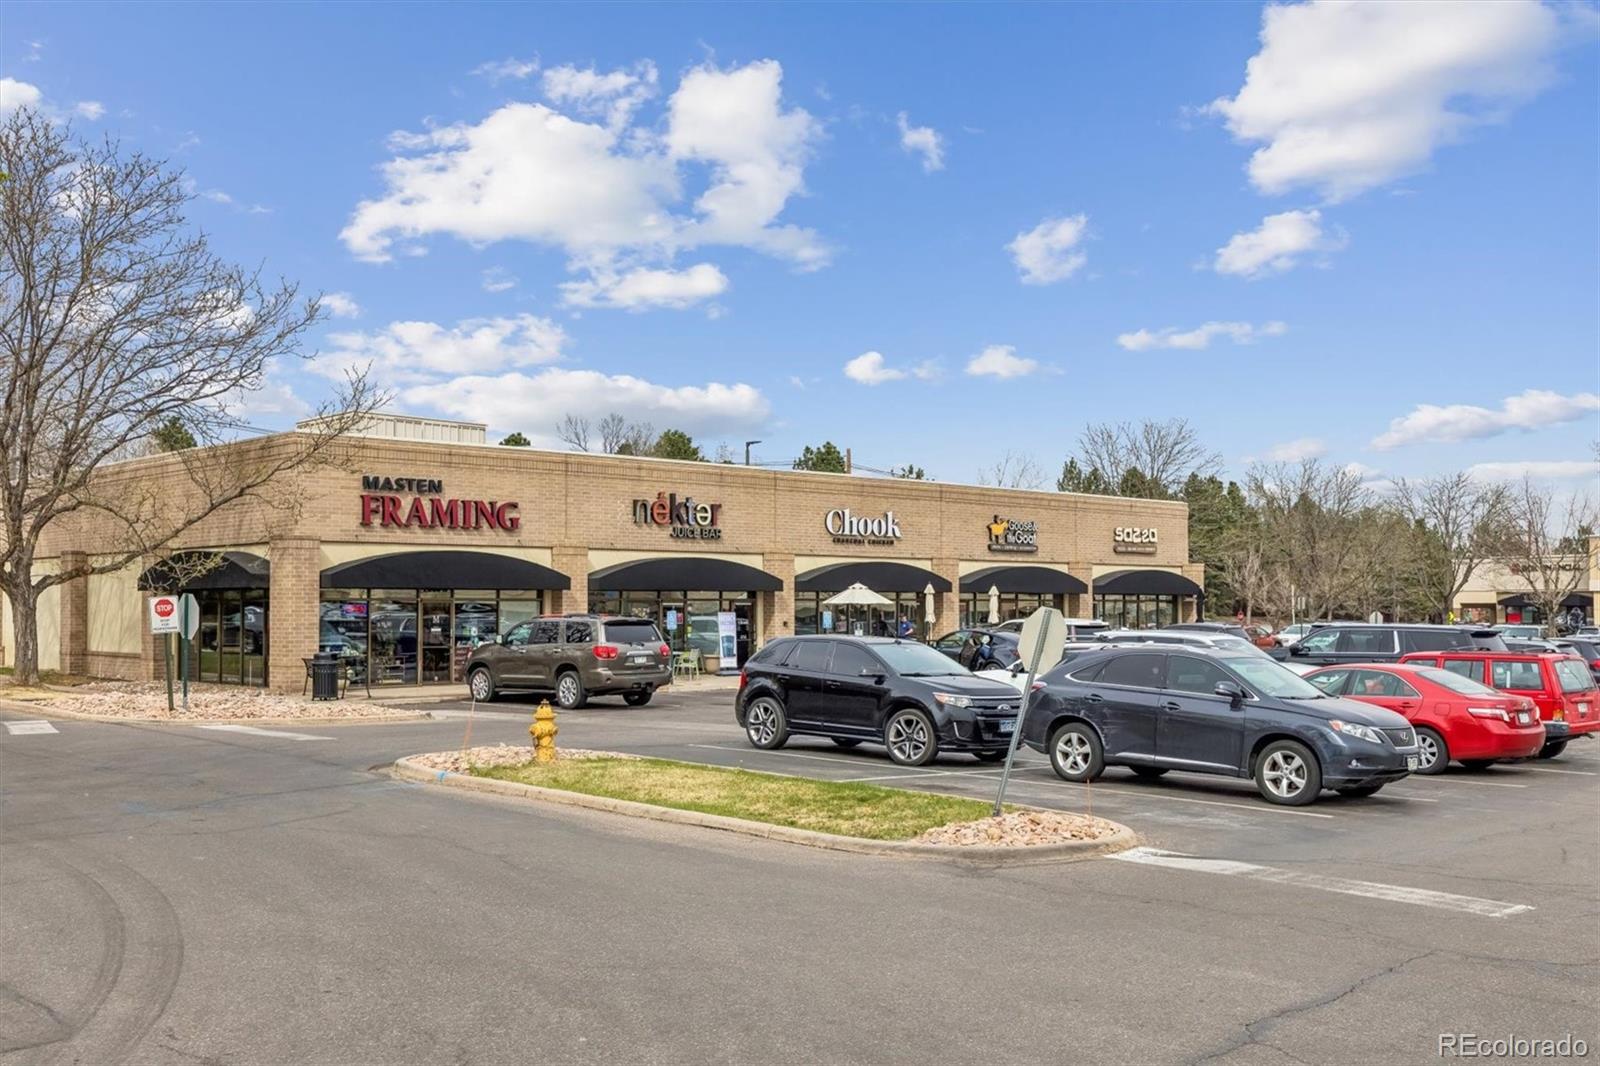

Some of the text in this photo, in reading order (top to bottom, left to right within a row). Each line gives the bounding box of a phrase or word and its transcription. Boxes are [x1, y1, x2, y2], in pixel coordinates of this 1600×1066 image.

[362, 475, 443, 493] MASTEN
[360, 494, 520, 531] FRAMING
[825, 508, 903, 538] Chook
[1008, 519, 1034, 531] Goose
[670, 526, 721, 539] JUICE BAR
[1015, 530, 1038, 544] Goat
[156, 604, 173, 612] STOP
